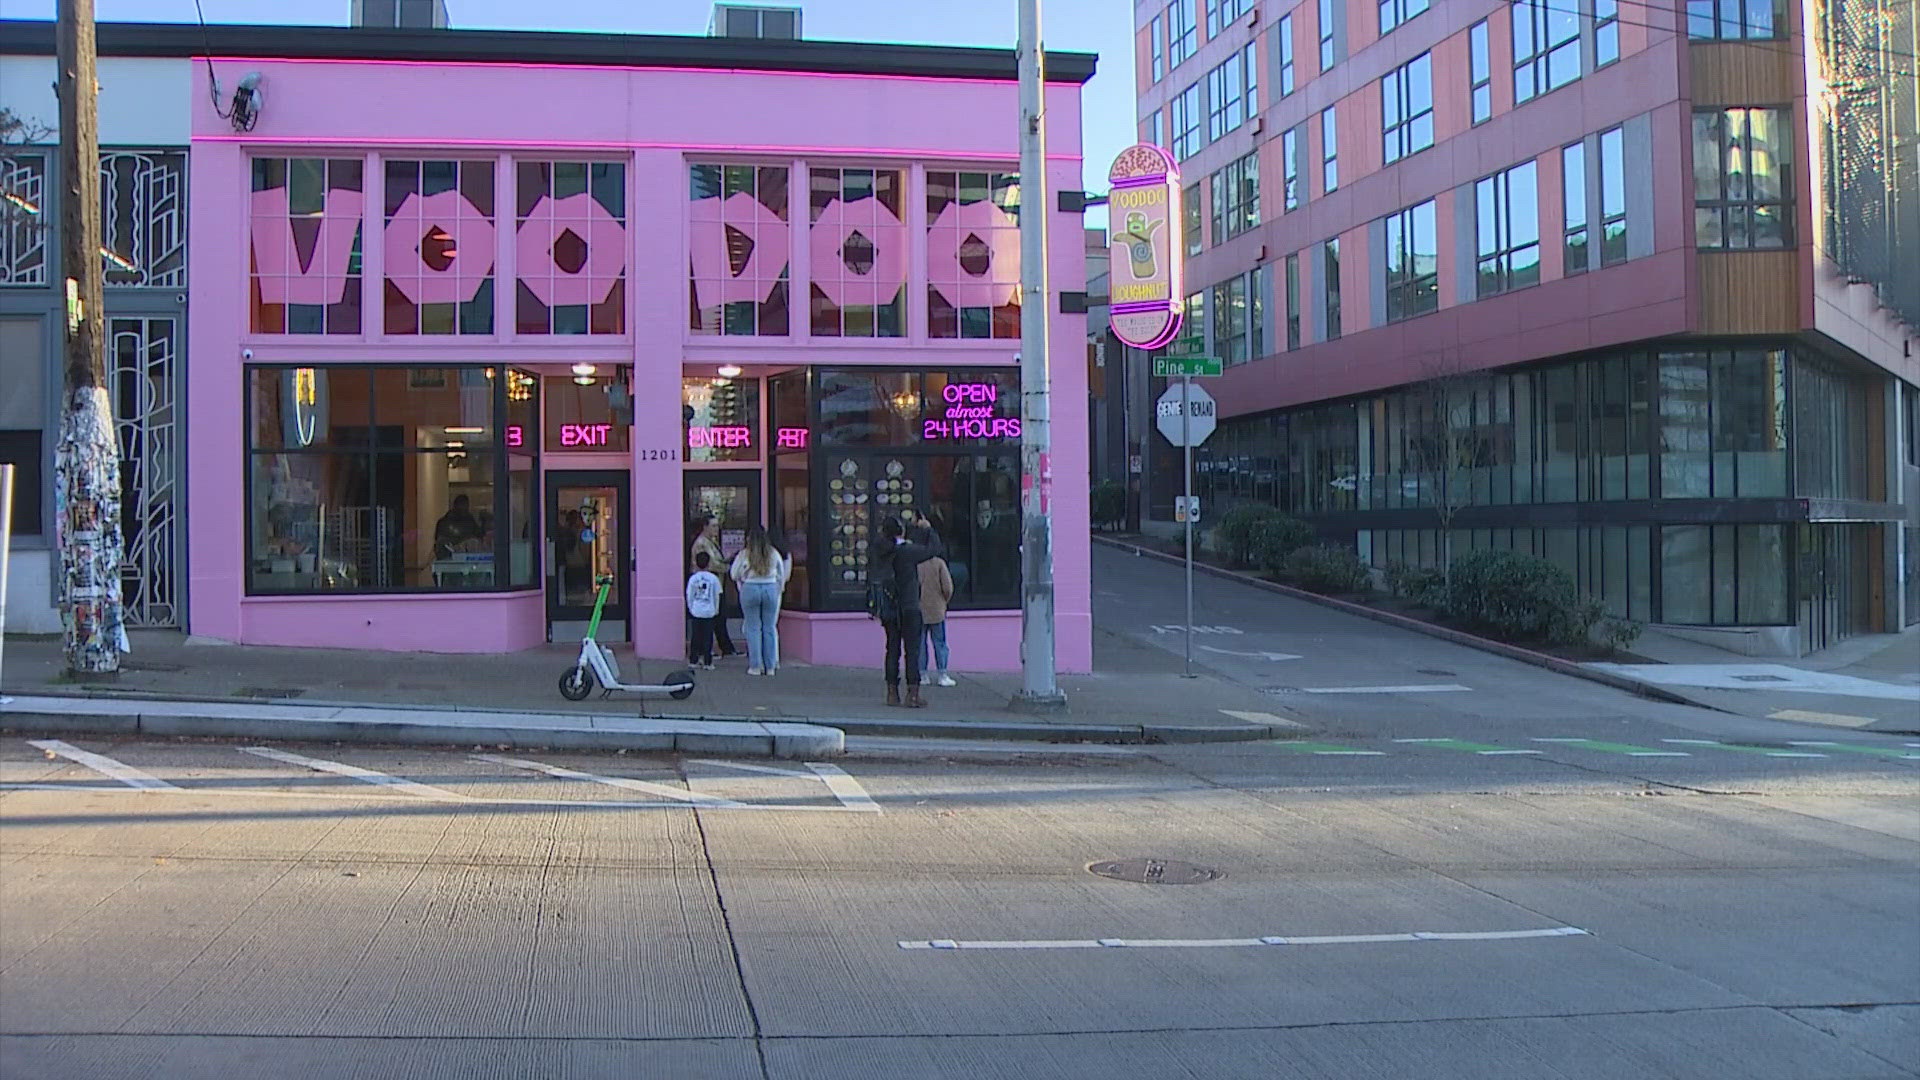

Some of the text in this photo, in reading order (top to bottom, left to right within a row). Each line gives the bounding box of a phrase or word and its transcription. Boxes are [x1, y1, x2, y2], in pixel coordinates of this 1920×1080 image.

[1112, 189, 1166, 208] VOODOO
[251, 186, 1021, 309] VOODOO
[1157, 359, 1204, 375] Pine St
[943, 384, 997, 402] OPEN
[946, 403, 994, 418] almost
[561, 424, 611, 447] EXIT
[688, 426, 750, 448] ENTER
[924, 419, 1021, 438] 24 HOURS
[641, 450, 676, 461] 1201
